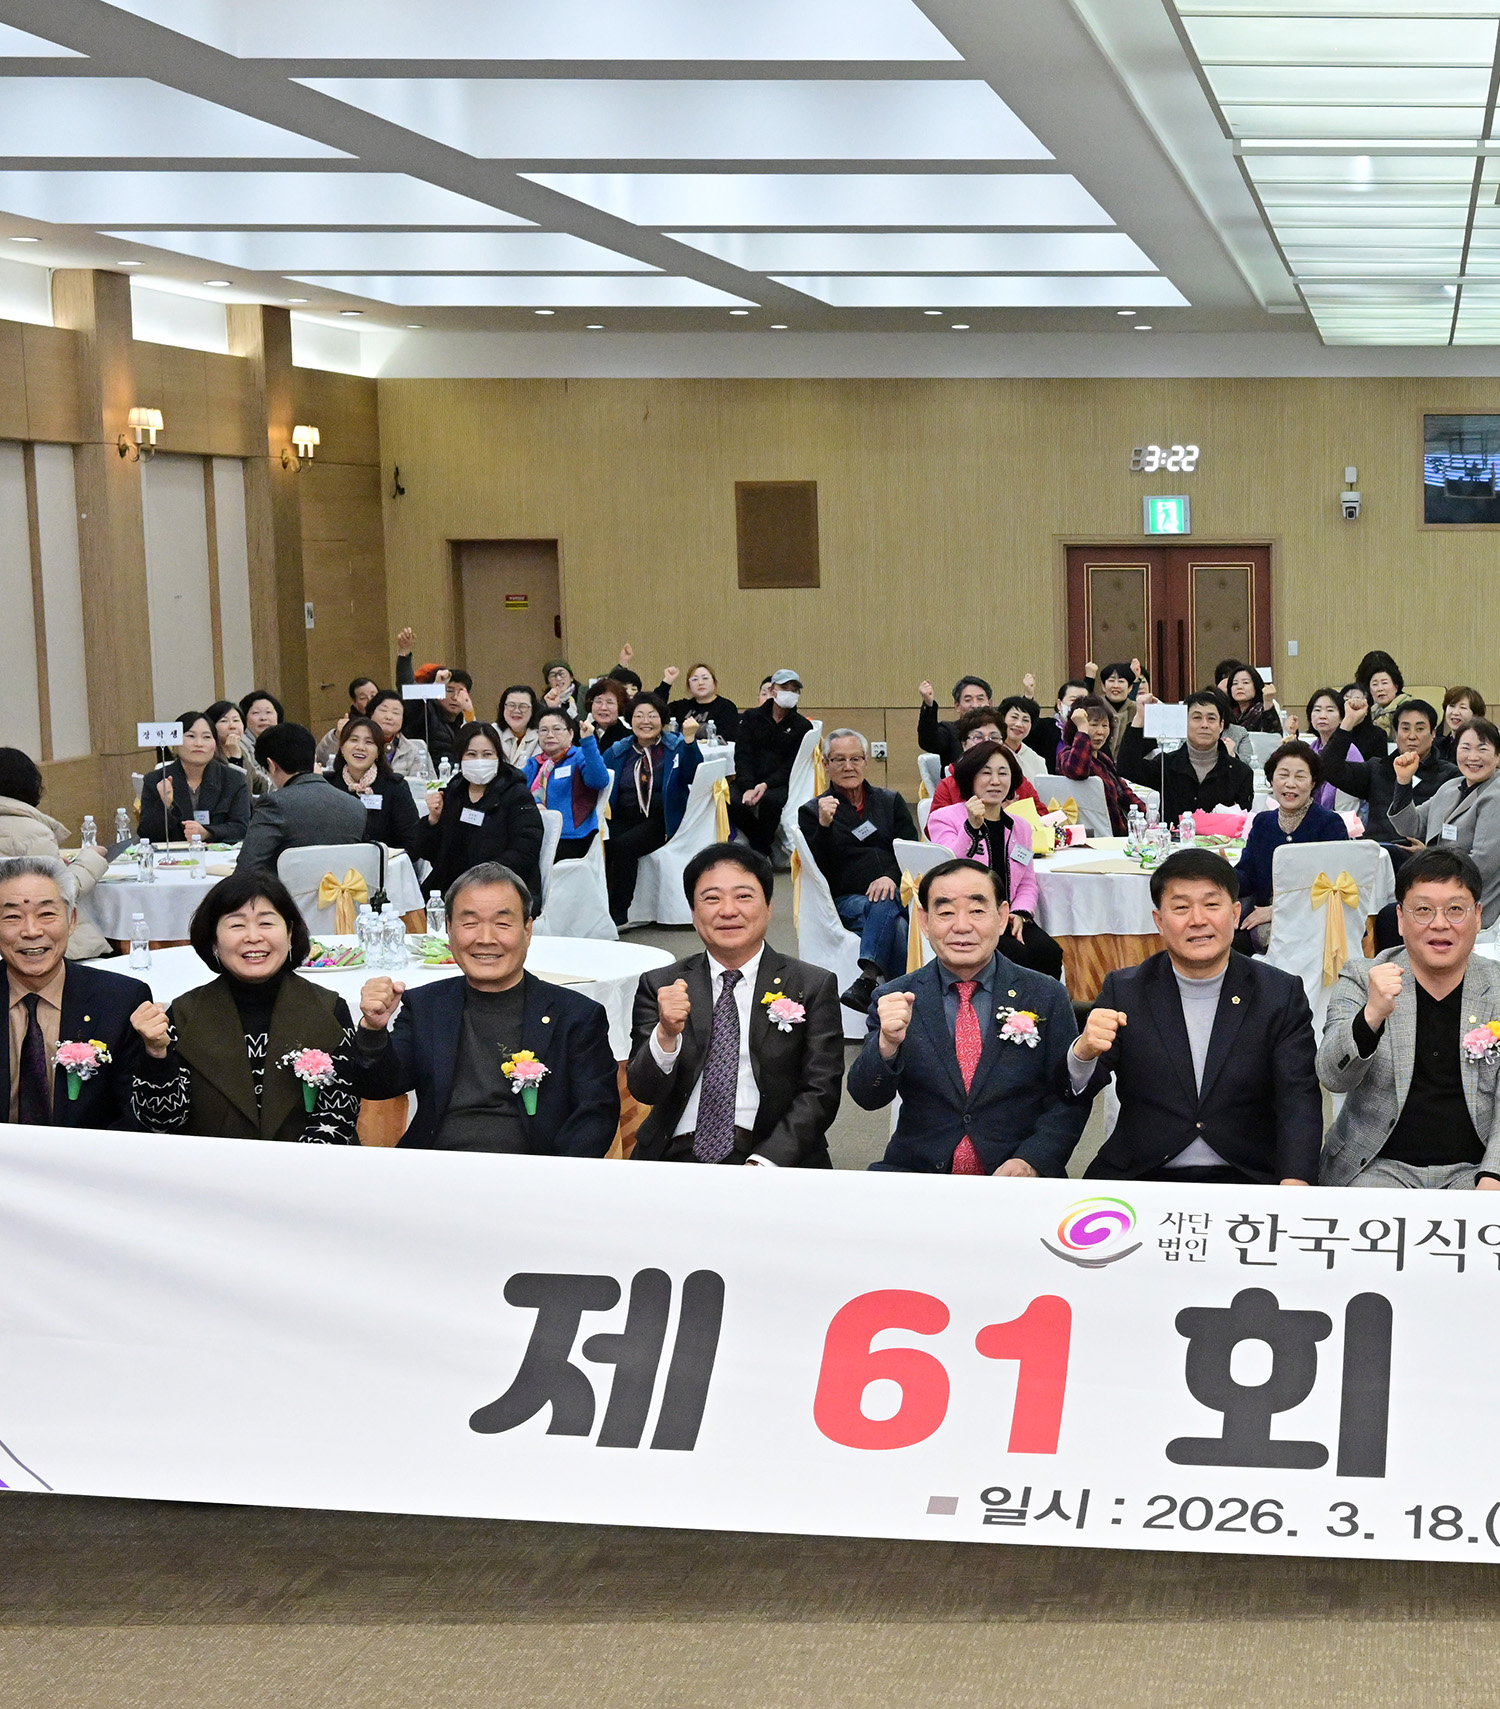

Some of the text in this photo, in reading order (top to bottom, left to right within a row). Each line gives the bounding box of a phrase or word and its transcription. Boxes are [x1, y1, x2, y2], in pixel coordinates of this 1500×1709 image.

[1144, 445, 1199, 472] 3:22
[1161, 1213, 1210, 1235] 사단
[1159, 1237, 1207, 1263] 법인
[981, 1486, 1090, 1529] 일시
[1143, 1495, 1298, 1537] 2026.
[1327, 1502, 1375, 1540] 3.
